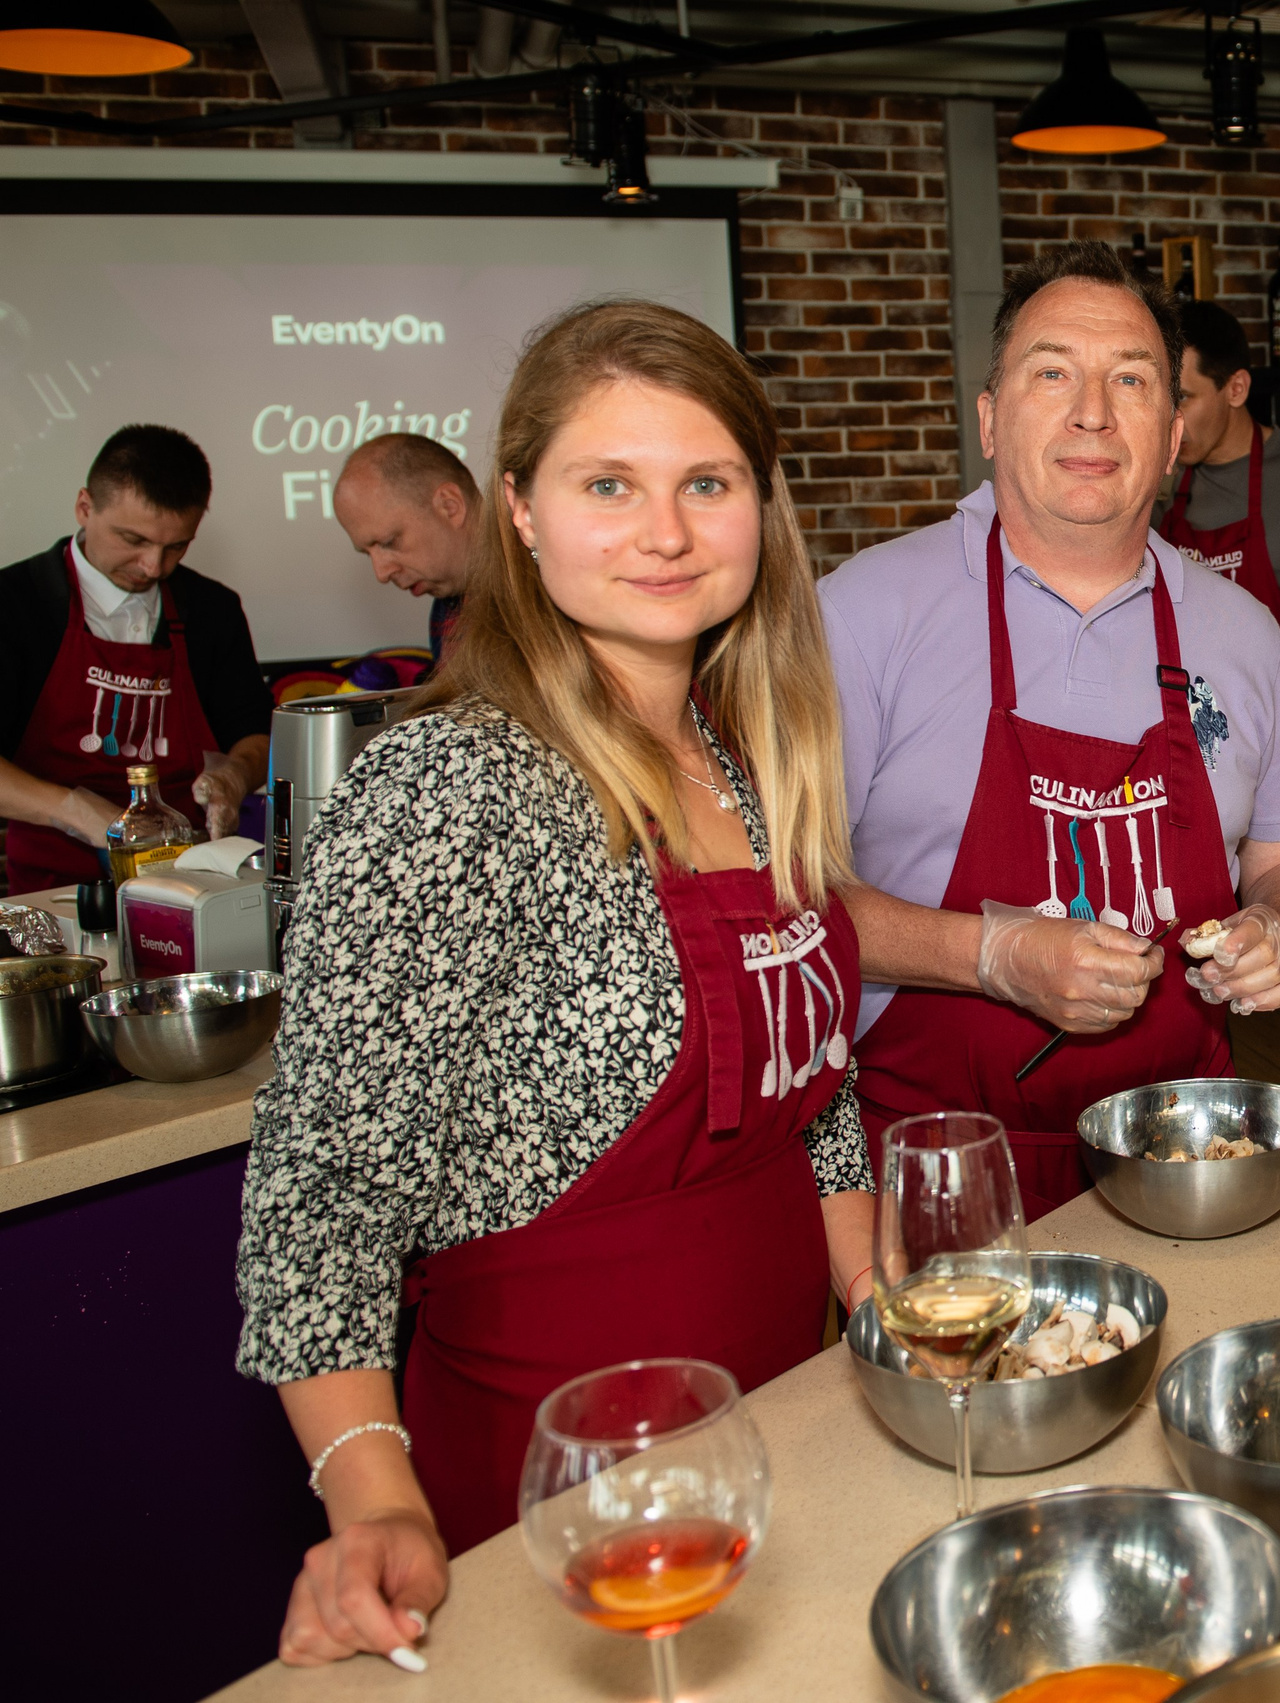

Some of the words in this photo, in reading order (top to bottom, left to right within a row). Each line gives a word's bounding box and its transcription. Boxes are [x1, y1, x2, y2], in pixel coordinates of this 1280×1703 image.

[271, 314, 446, 350] EventyOn
[251, 400, 472, 460] Cooking
[140, 934, 182, 956] EventyOn
